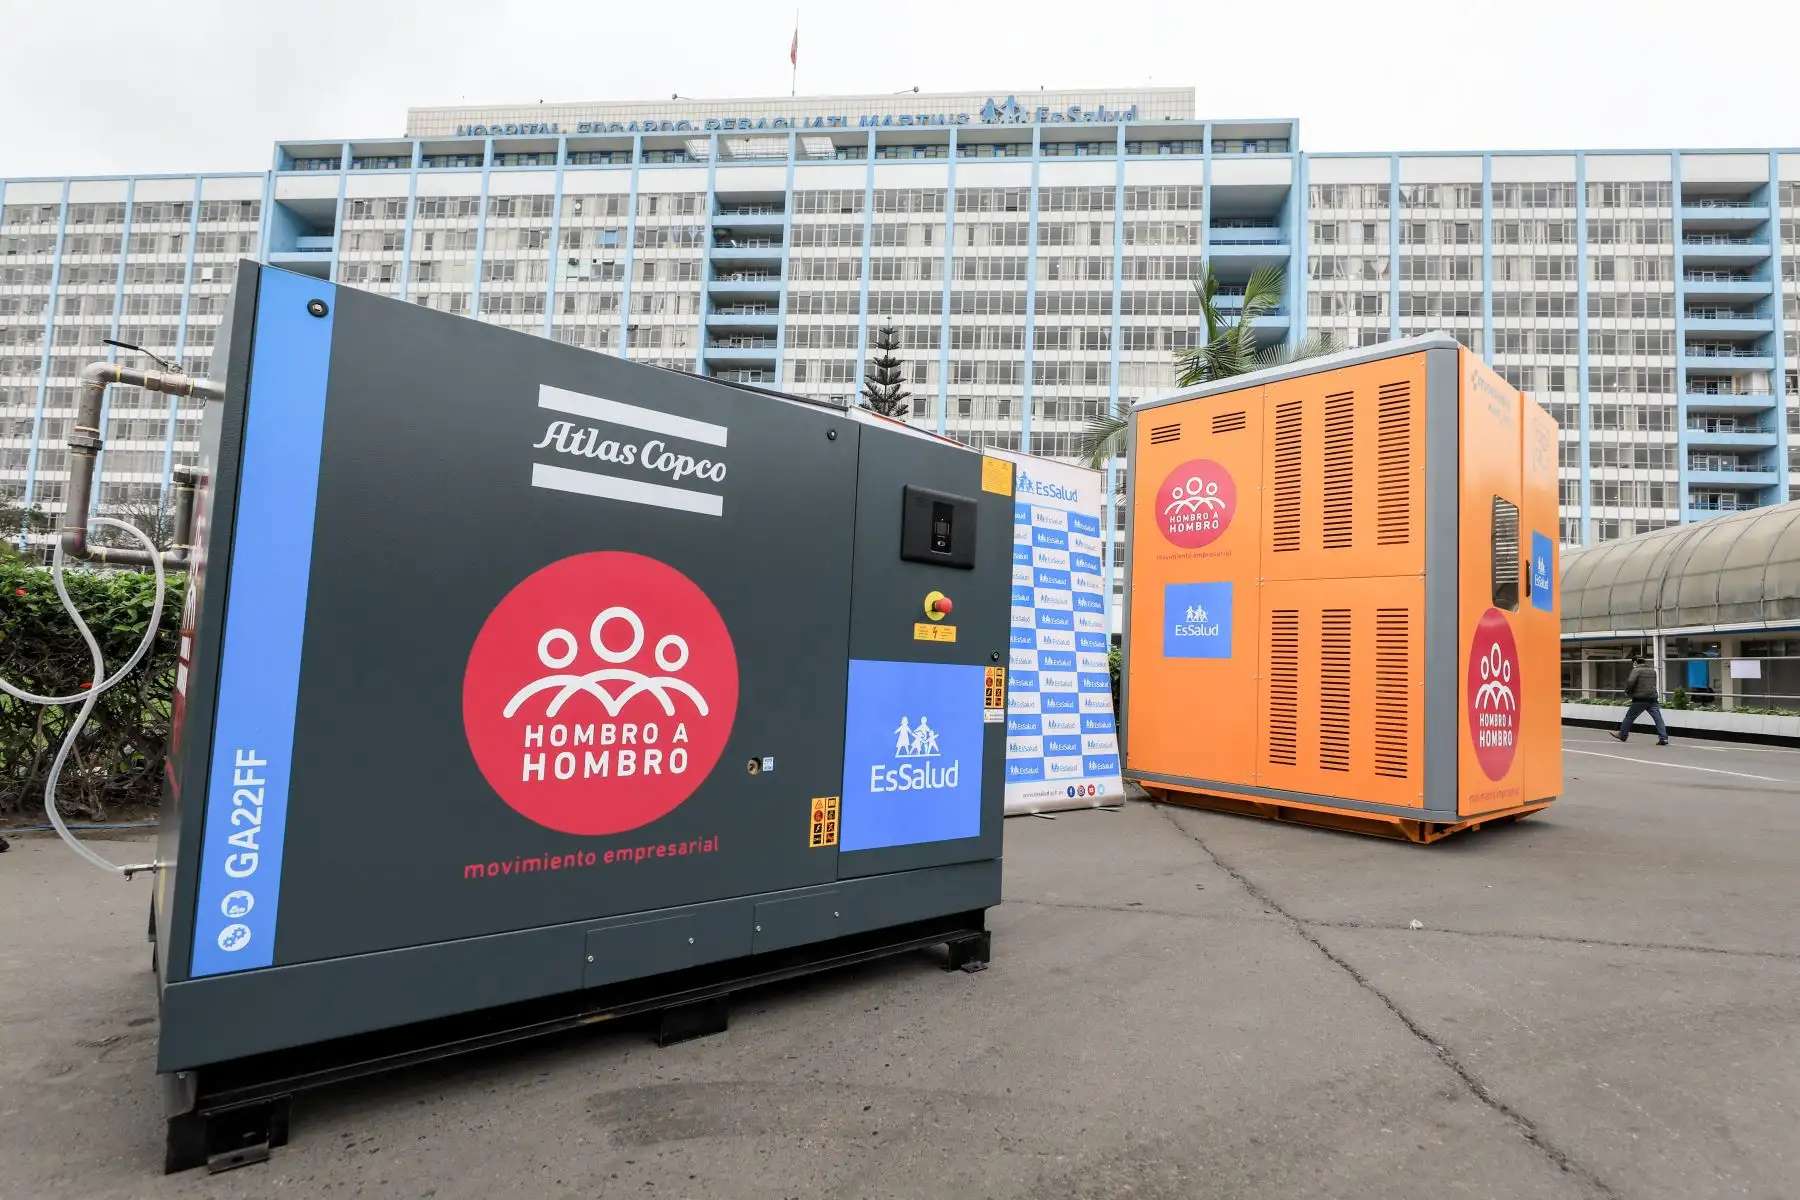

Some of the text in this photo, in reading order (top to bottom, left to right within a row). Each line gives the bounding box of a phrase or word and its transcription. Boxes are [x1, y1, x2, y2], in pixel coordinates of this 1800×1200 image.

[533, 420, 727, 482] Atlas Copco
[1036, 481, 1078, 502] EsSalud
[1169, 510, 1219, 523] HOMBRO A
[1169, 519, 1219, 533] HOMBRO
[1175, 623, 1219, 636] EsSalud
[1479, 713, 1513, 727] HOMBRO A
[524, 722, 689, 748] HOMBRO A
[1479, 730, 1512, 747] HOMBRO
[521, 747, 689, 782] HOMBRO
[870, 759, 959, 792] EsSalud
[224, 749, 267, 878] GA22FF
[464, 835, 719, 879] movimiento empresarial
